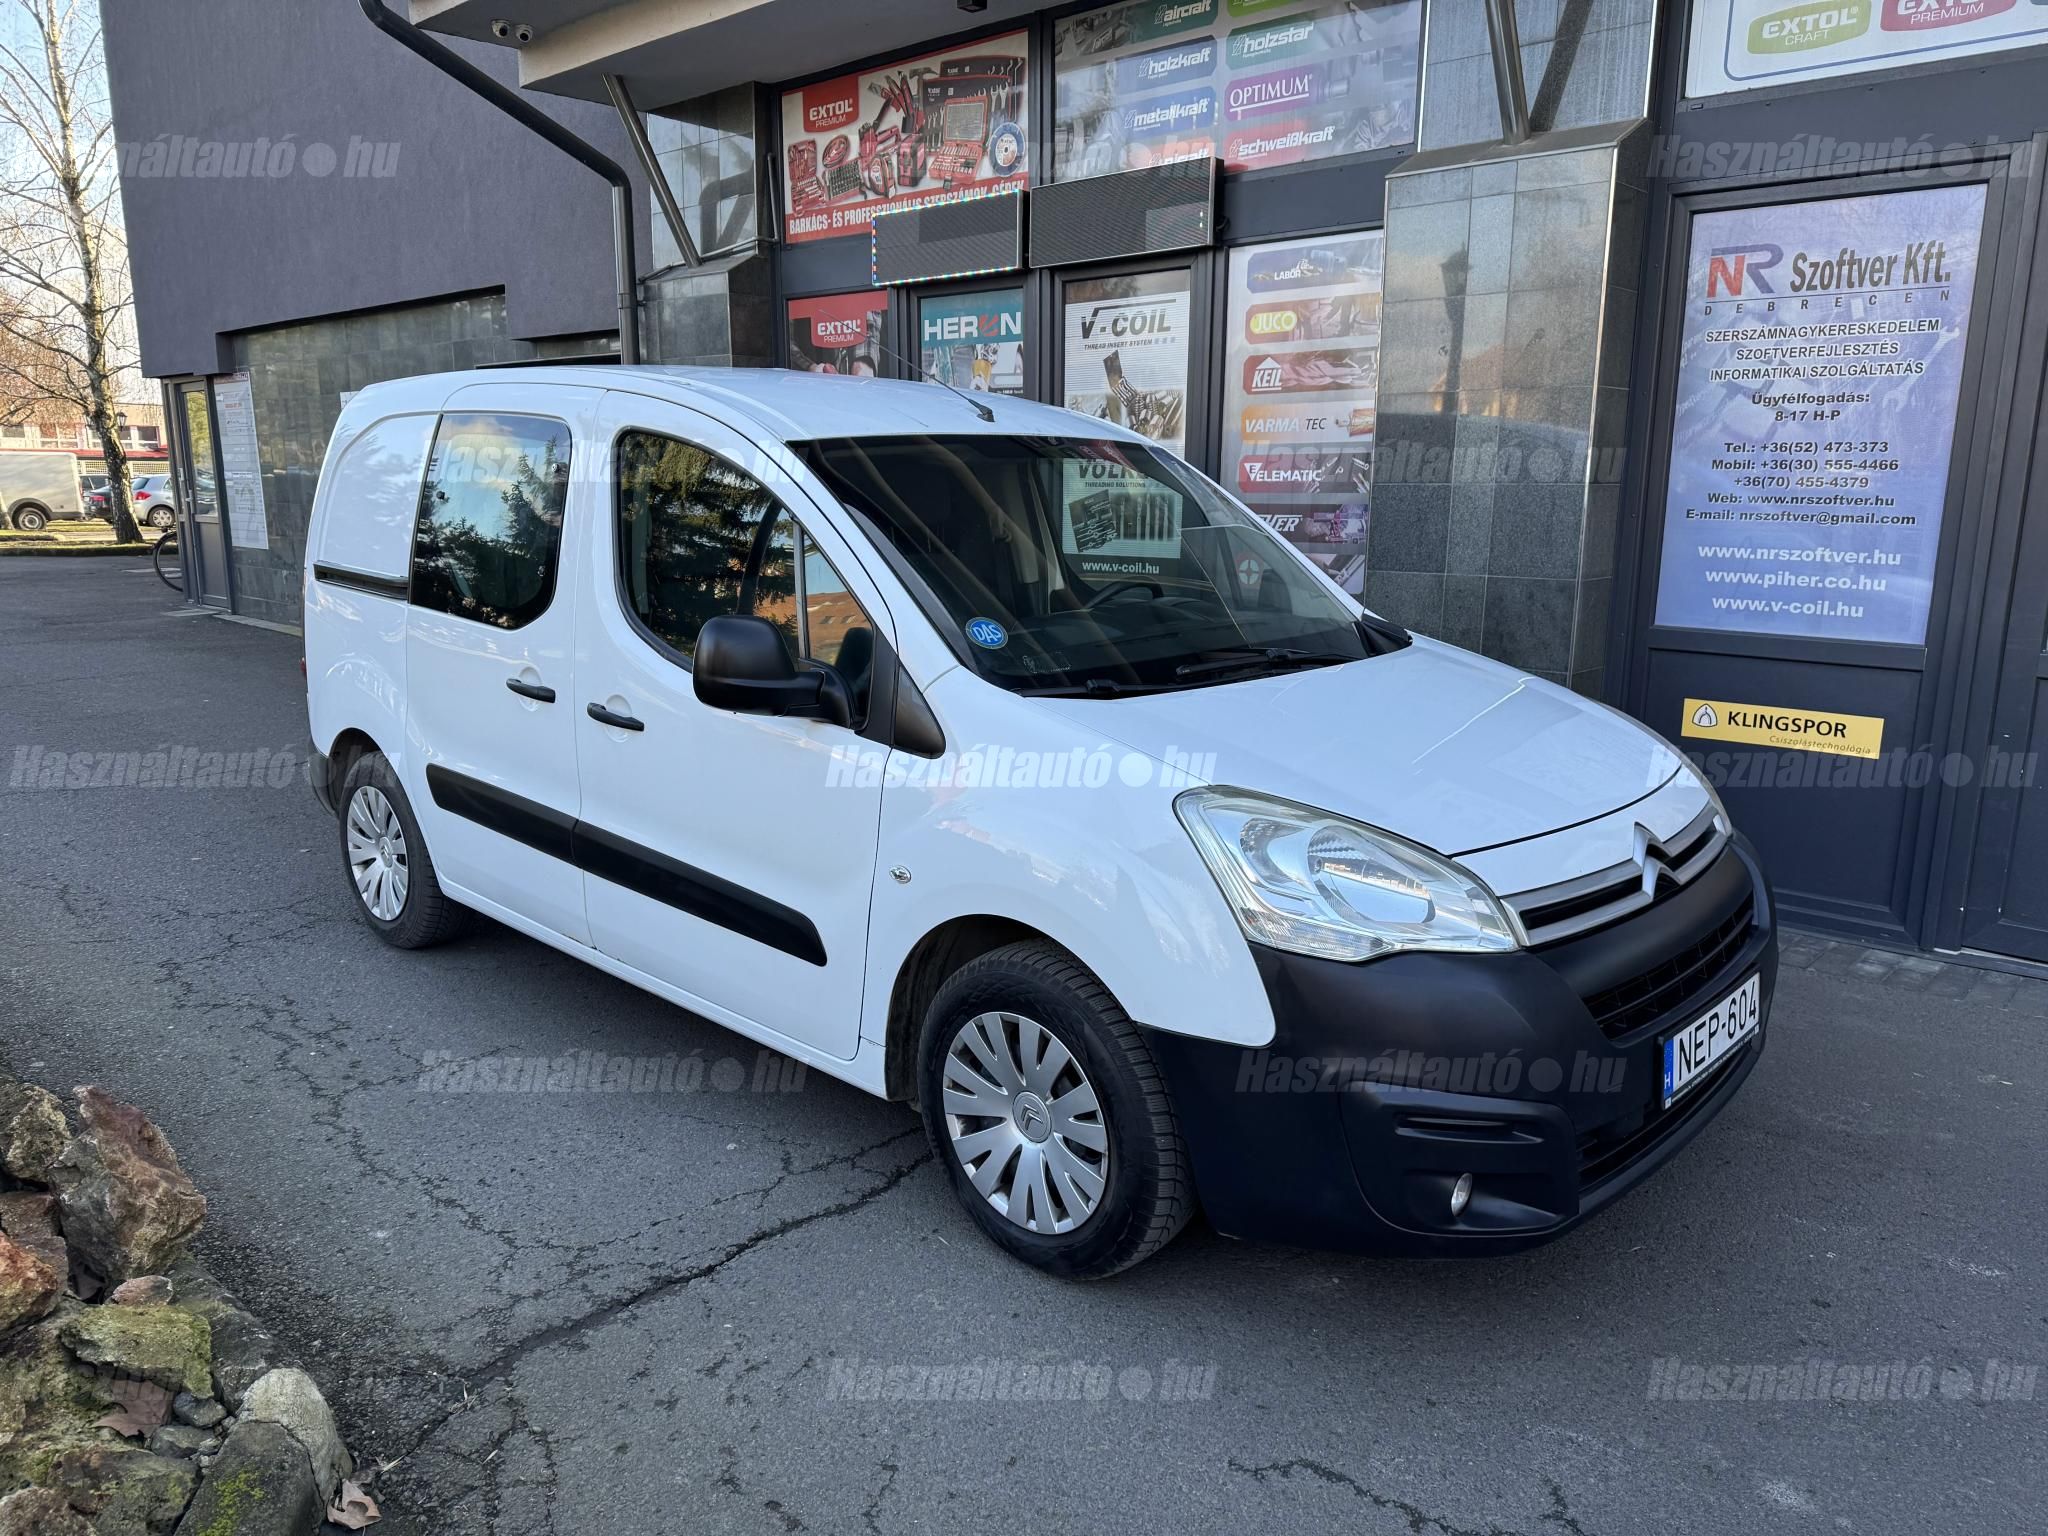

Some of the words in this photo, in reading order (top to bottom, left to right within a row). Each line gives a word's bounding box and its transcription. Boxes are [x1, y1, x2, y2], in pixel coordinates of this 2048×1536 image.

[1164, 0, 1211, 22] aircraft
[1911, 3, 1984, 24] PREMIUM
[1762, 8, 1857, 38] EXTOL
[1244, 23, 1313, 52] holzstar
[1785, 29, 1829, 46] CRAFT
[1148, 48, 1211, 74] holzkraft
[1230, 77, 1309, 107] OPTIMUM
[809, 100, 852, 121] EXTOL
[1134, 98, 1209, 126] metallkraft
[815, 115, 847, 128] PREMIUM
[1238, 126, 1335, 156] schweißkraft
[789, 215, 831, 235] BARKÁCS-
[832, 211, 843, 228] ÉS
[1706, 243, 1784, 298] NR
[1789, 248, 1898, 292] Szoftver
[1902, 240, 1951, 285] Kft.
[817, 319, 859, 336] EXTOL
[1255, 311, 1297, 331] JUCO
[1705, 319, 1940, 342] SZERSZÁMNAGYKERESKEDELEM
[823, 333, 854, 343] PREMIUM
[1736, 341, 1899, 361] SZOFTVERFEJLESZTÉS
[1252, 368, 1283, 388] KEIL
[1710, 366, 1806, 382] INFORMATIKAI
[1809, 361, 1924, 378] SZOLGÁLTATÁS
[1751, 391, 1870, 407] Ügyfélfogadás:
[1244, 418, 1300, 433] VARMA
[1305, 417, 1327, 431] TEC
[1774, 411, 1807, 422] 8-17
[1813, 410, 1840, 421] H-P
[1724, 442, 1756, 453] Tel.:
[1760, 441, 1818, 456] +36(52)
[1824, 441, 1889, 453] 473-373
[1256, 469, 1322, 482] ELEMATIC
[1711, 459, 1756, 471] Mobil:
[1760, 459, 1818, 473] +36(30)
[1824, 459, 1899, 471] 555-4466
[1734, 476, 1790, 489] +36(70)
[1795, 476, 1869, 488] 455-4379
[1707, 493, 1742, 504] Web:
[1747, 494, 1895, 506] www.nrszoftver.hu
[1685, 508, 1736, 521] E-mail:
[1739, 511, 1916, 526] nrszoftver@gmail.com
[1698, 545, 1901, 566] www.nrszoftver.hu
[1082, 560, 1160, 575] www.v-coil.hu
[1705, 569, 1887, 591] www.piher.co.hu
[1711, 596, 1864, 618] www.v-coil.hu
[972, 623, 1001, 643] DAS
[1727, 710, 1848, 739] KLINGSPOR
[1769, 734, 1872, 756] Csiszolástechnológia
[1678, 981, 1757, 1082] NEP-604
